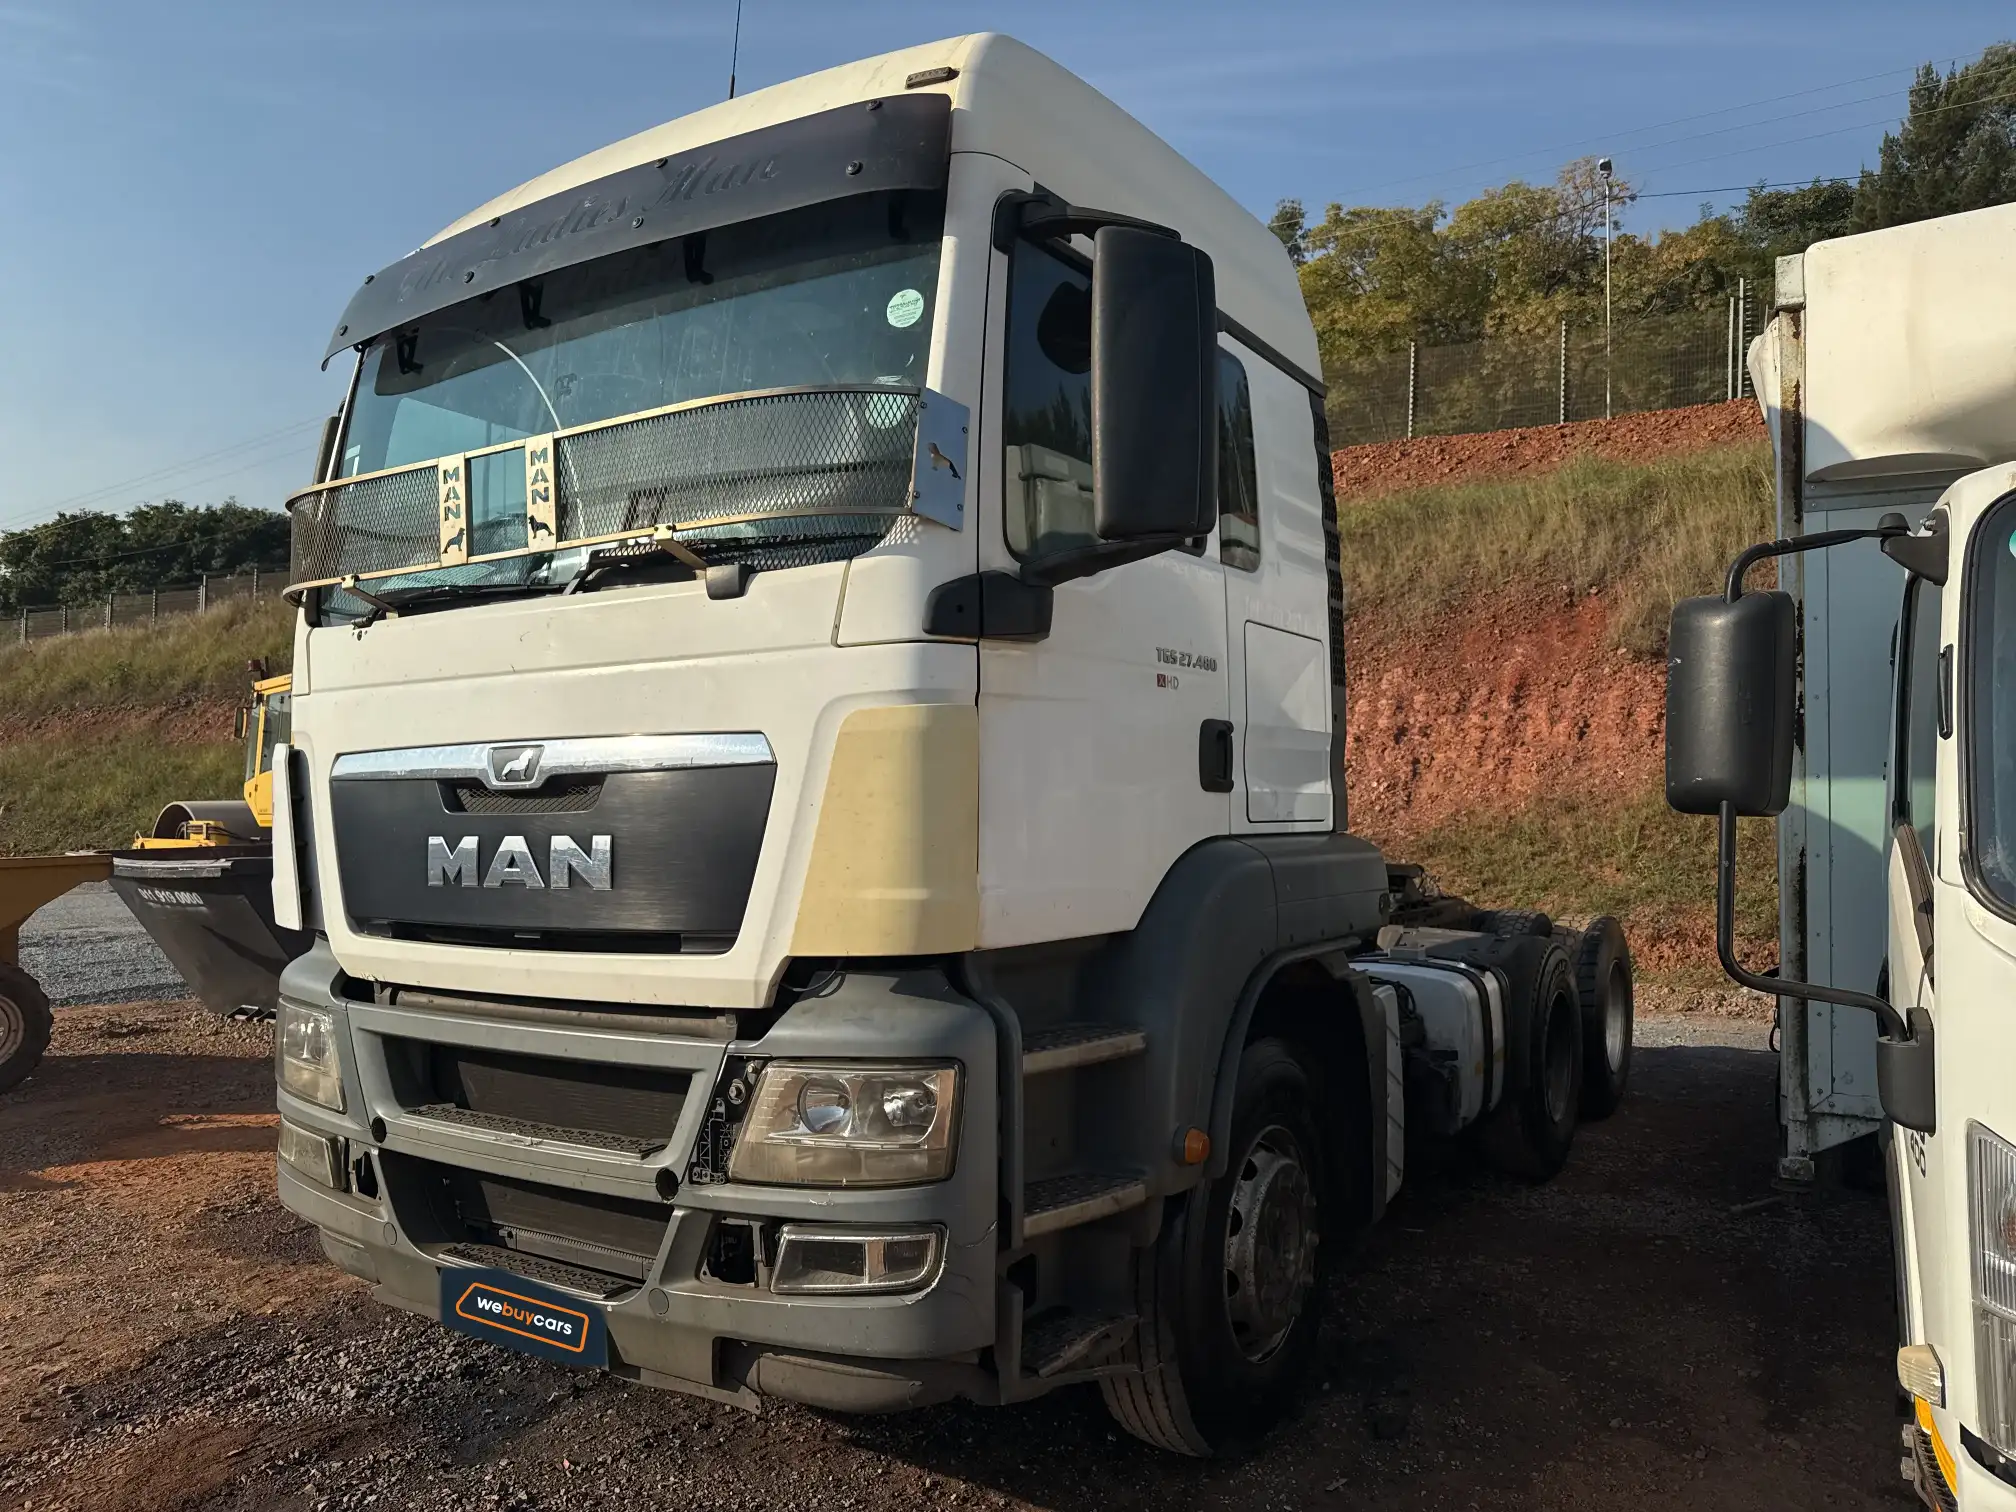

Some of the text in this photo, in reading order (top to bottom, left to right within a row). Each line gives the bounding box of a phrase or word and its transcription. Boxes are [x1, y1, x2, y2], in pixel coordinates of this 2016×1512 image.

[478, 194, 632, 270] Ladies
[641, 156, 782, 212] Man
[443, 466, 460, 521] MAN
[531, 447, 549, 505] MAN
[1156, 646, 1218, 672] TGS 27.480
[1156, 673, 1179, 690] XHD
[428, 835, 612, 890] MAN
